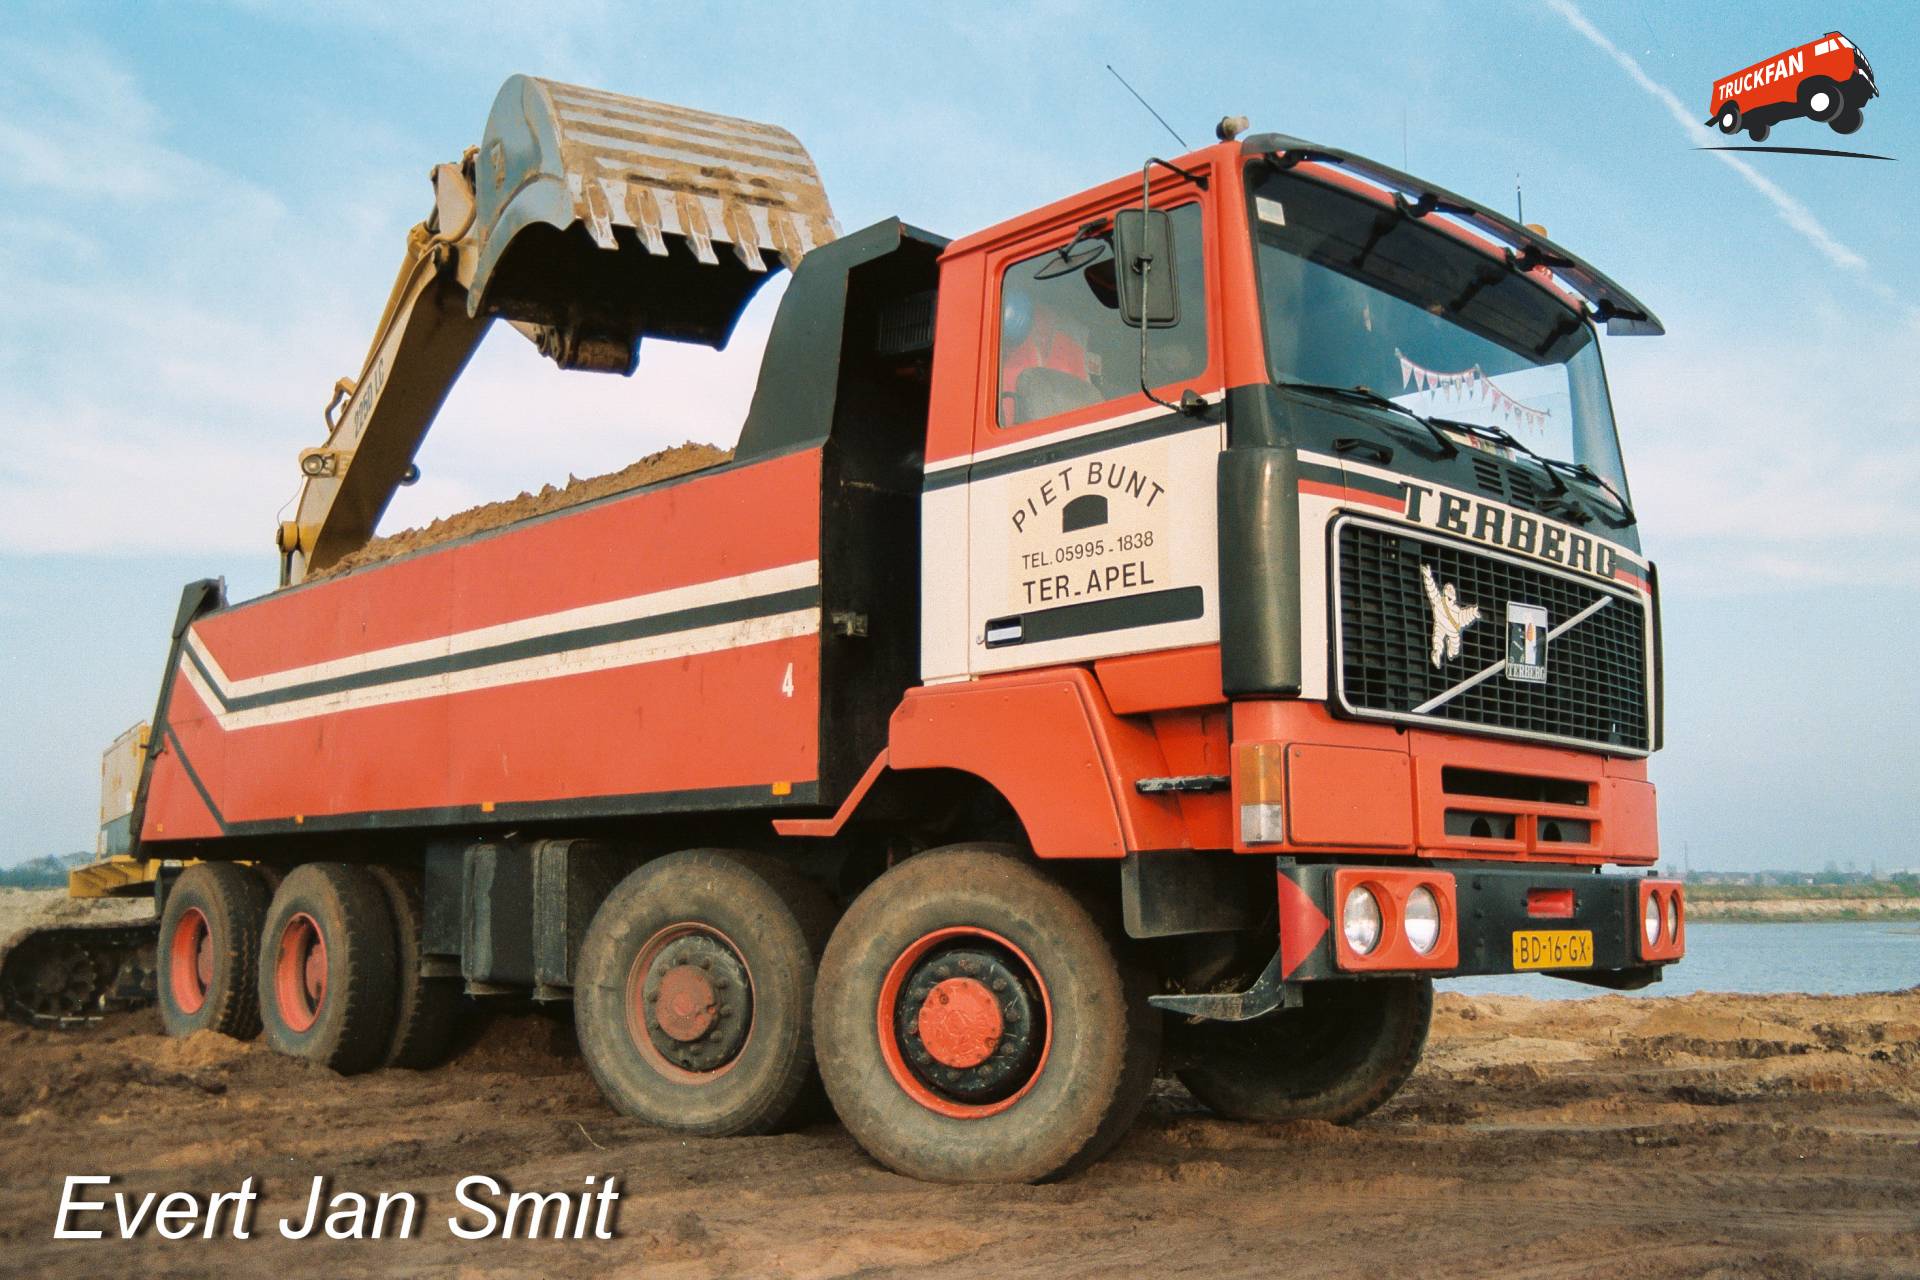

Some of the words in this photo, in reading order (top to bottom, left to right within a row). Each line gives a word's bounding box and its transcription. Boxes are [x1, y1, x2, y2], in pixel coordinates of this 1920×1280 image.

[1012, 467, 1073, 533] PIET
[1087, 461, 1165, 507] BUNT
[1400, 480, 1617, 580] TERBERG
[782, 662, 794, 697] 4
[1508, 663, 1546, 680] TERBERG
[1520, 935, 1587, 963] BD-16-GX
